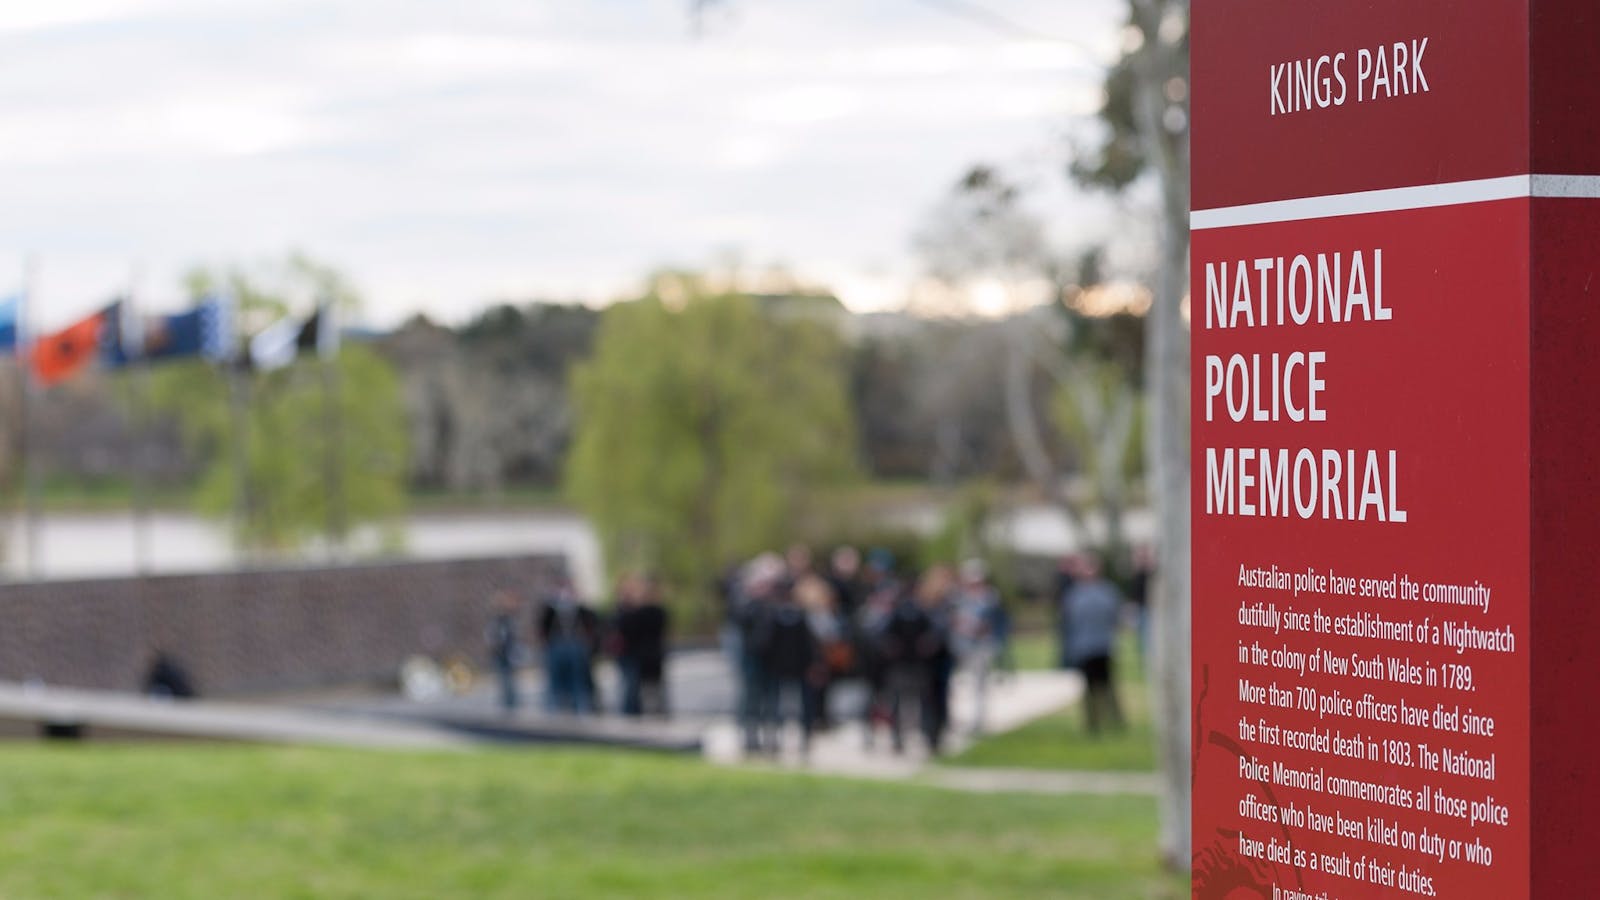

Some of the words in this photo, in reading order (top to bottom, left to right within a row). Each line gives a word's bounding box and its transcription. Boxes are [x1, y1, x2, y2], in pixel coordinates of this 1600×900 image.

[1271, 53, 1346, 115] KINGS
[1358, 38, 1429, 101] PARK
[1206, 249, 1392, 329] NATIONAL
[1206, 352, 1326, 422] POLICE
[1207, 448, 1407, 522] MEMORIAL
[1238, 564, 1290, 590] Australian
[1295, 568, 1326, 597] police
[1330, 569, 1356, 595] have
[1360, 574, 1396, 598] served
[1400, 574, 1419, 600] the
[1423, 580, 1490, 613] community
[1239, 601, 1281, 634] dutifully
[1284, 607, 1310, 631] since
[1313, 608, 1331, 633] the
[1335, 612, 1413, 642] establishment
[1417, 618, 1429, 643] of
[1432, 626, 1439, 644] a
[1444, 621, 1514, 654] Nightwatch
[1239, 640, 1248, 663] in
[1251, 641, 1268, 665] the
[1271, 644, 1305, 676] colony
[1309, 648, 1320, 672] of
[1324, 650, 1348, 675] New
[1352, 653, 1383, 680] South
[1387, 657, 1422, 685] Wales
[1426, 661, 1436, 686] in
[1442, 664, 1475, 691] 1789.
[1240, 679, 1266, 704] More
[1269, 682, 1292, 708] than
[1296, 687, 1316, 711] 700
[1320, 690, 1352, 719] police
[1356, 694, 1397, 723] officers
[1401, 699, 1429, 727] have
[1433, 704, 1458, 731] died
[1463, 709, 1494, 736] since
[1239, 716, 1255, 741] the
[1259, 719, 1280, 745] first
[1283, 727, 1329, 753] recorded
[1333, 731, 1364, 759] death
[1368, 736, 1378, 761] in
[1383, 739, 1414, 767] 1803.
[1418, 744, 1438, 771] The
[1443, 748, 1494, 780] National
[1240, 756, 1269, 782] Police
[1273, 761, 1323, 792] Memorial
[1327, 777, 1412, 808] commemorates
[1416, 785, 1430, 811] all
[1434, 788, 1467, 818] those
[1471, 796, 1508, 826] police
[1239, 794, 1277, 822] officers
[1281, 802, 1304, 827] who
[1308, 805, 1333, 833] have
[1337, 811, 1363, 840] been
[1368, 816, 1397, 847] killed
[1402, 830, 1416, 851] on
[1420, 827, 1445, 863] duty
[1449, 840, 1462, 859] or
[1465, 837, 1492, 866] who
[1240, 831, 1264, 859] have
[1267, 837, 1290, 864] died
[1294, 849, 1306, 867] as
[1310, 853, 1317, 870] a
[1321, 852, 1350, 877] result
[1354, 856, 1365, 880] of
[1369, 858, 1395, 887] their
[1399, 864, 1436, 896] duties.
